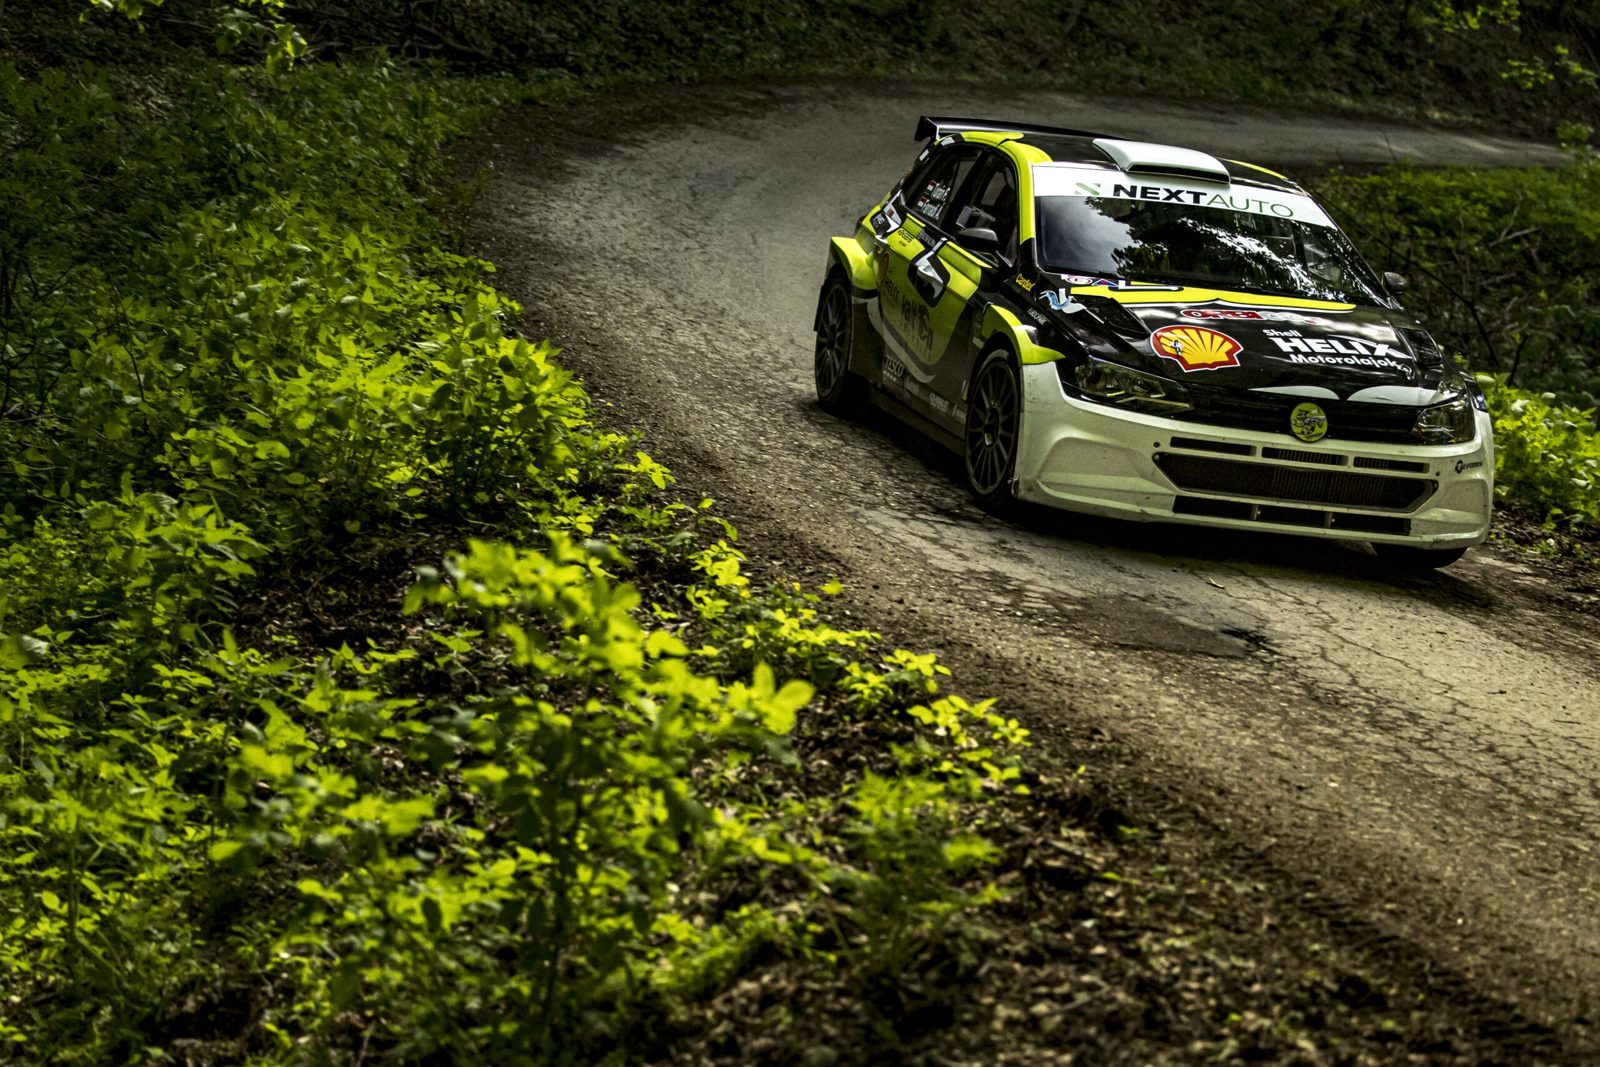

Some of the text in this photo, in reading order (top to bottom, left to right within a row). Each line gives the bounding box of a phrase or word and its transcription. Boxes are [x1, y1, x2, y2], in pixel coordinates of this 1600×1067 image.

[1113, 184, 1294, 217] NEXTAUTO
[1262, 329, 1303, 338] Shell
[1268, 335, 1412, 359] HELIX
[1289, 354, 1400, 369] Motorolajok
